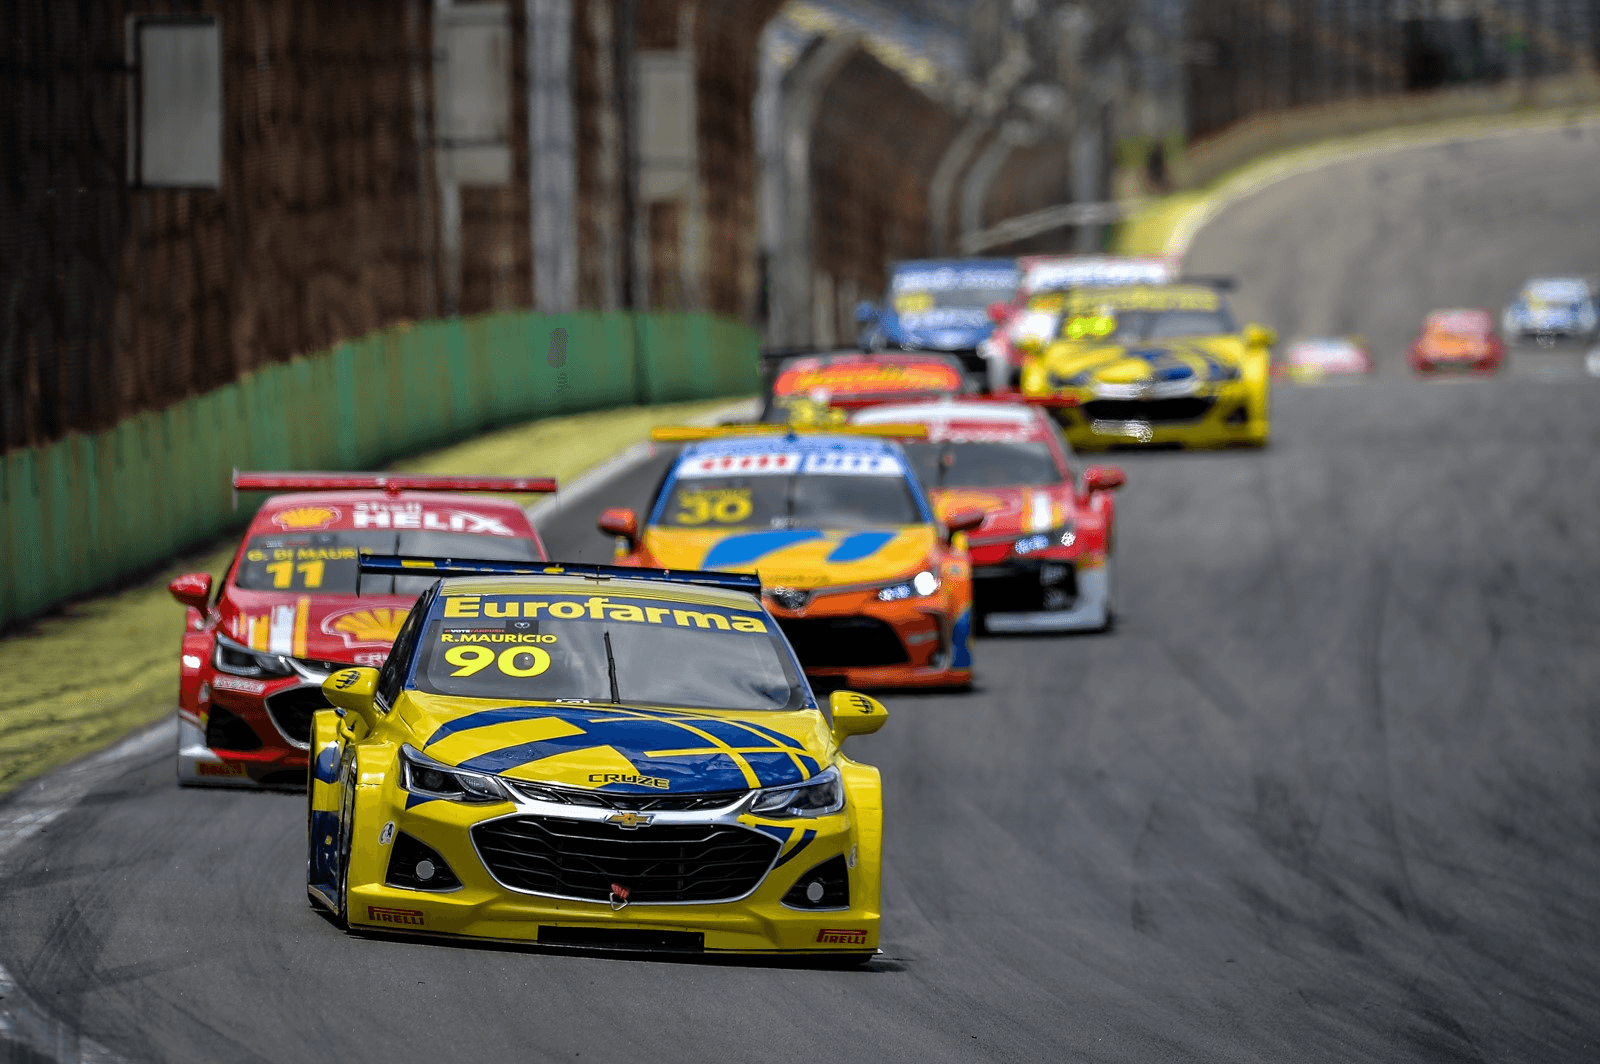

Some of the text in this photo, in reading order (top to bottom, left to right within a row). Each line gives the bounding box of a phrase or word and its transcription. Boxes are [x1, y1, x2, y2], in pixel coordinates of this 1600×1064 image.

[353, 510, 515, 536] HELIX
[266, 560, 325, 589] 11
[443, 596, 768, 634] Eurofarma
[444, 645, 551, 678] 90
[588, 774, 670, 790] CRUZE
[367, 905, 425, 926] PIRELLI
[816, 928, 868, 945] PIRELLI
